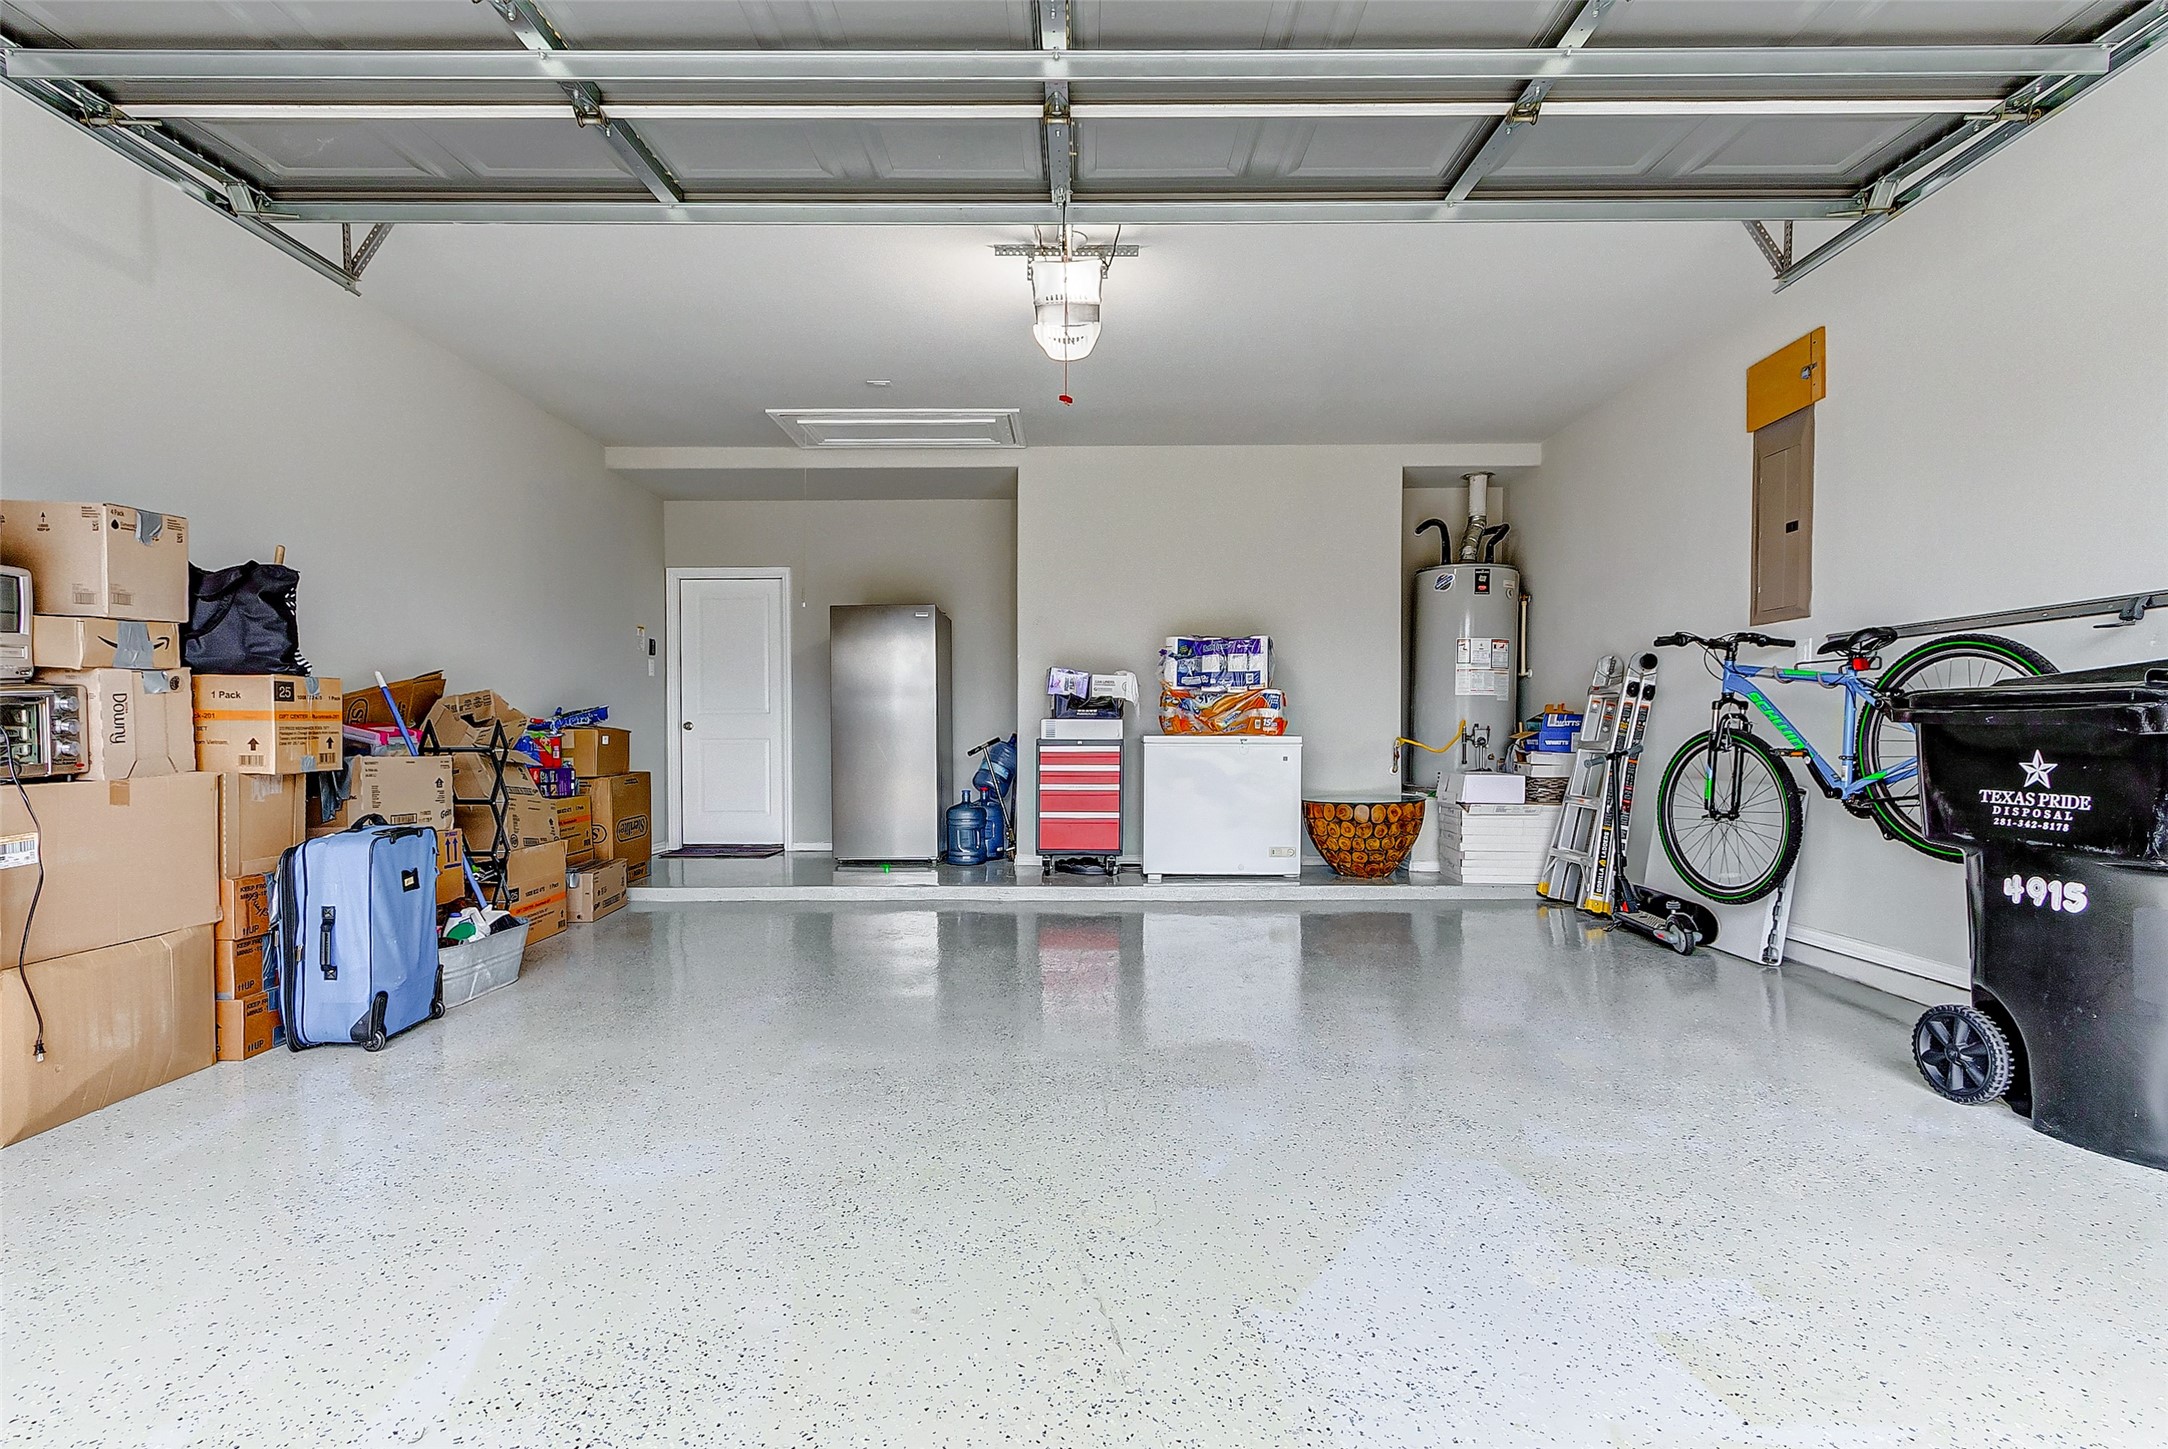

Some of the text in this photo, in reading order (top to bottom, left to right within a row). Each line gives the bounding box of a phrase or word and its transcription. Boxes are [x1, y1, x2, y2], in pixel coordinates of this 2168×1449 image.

[211, 690, 242, 699] 1 Pack
[279, 686, 292, 698] 25
[109, 693, 127, 744] Downy
[1979, 789, 2092, 811] TEXAS PRIDE
[1992, 805, 2073, 821] DISPOSAL
[1993, 818, 2070, 832] 281-342-8178
[1595, 831, 1610, 893] GORILLA LADDERS
[2003, 874, 2088, 913] 4915
